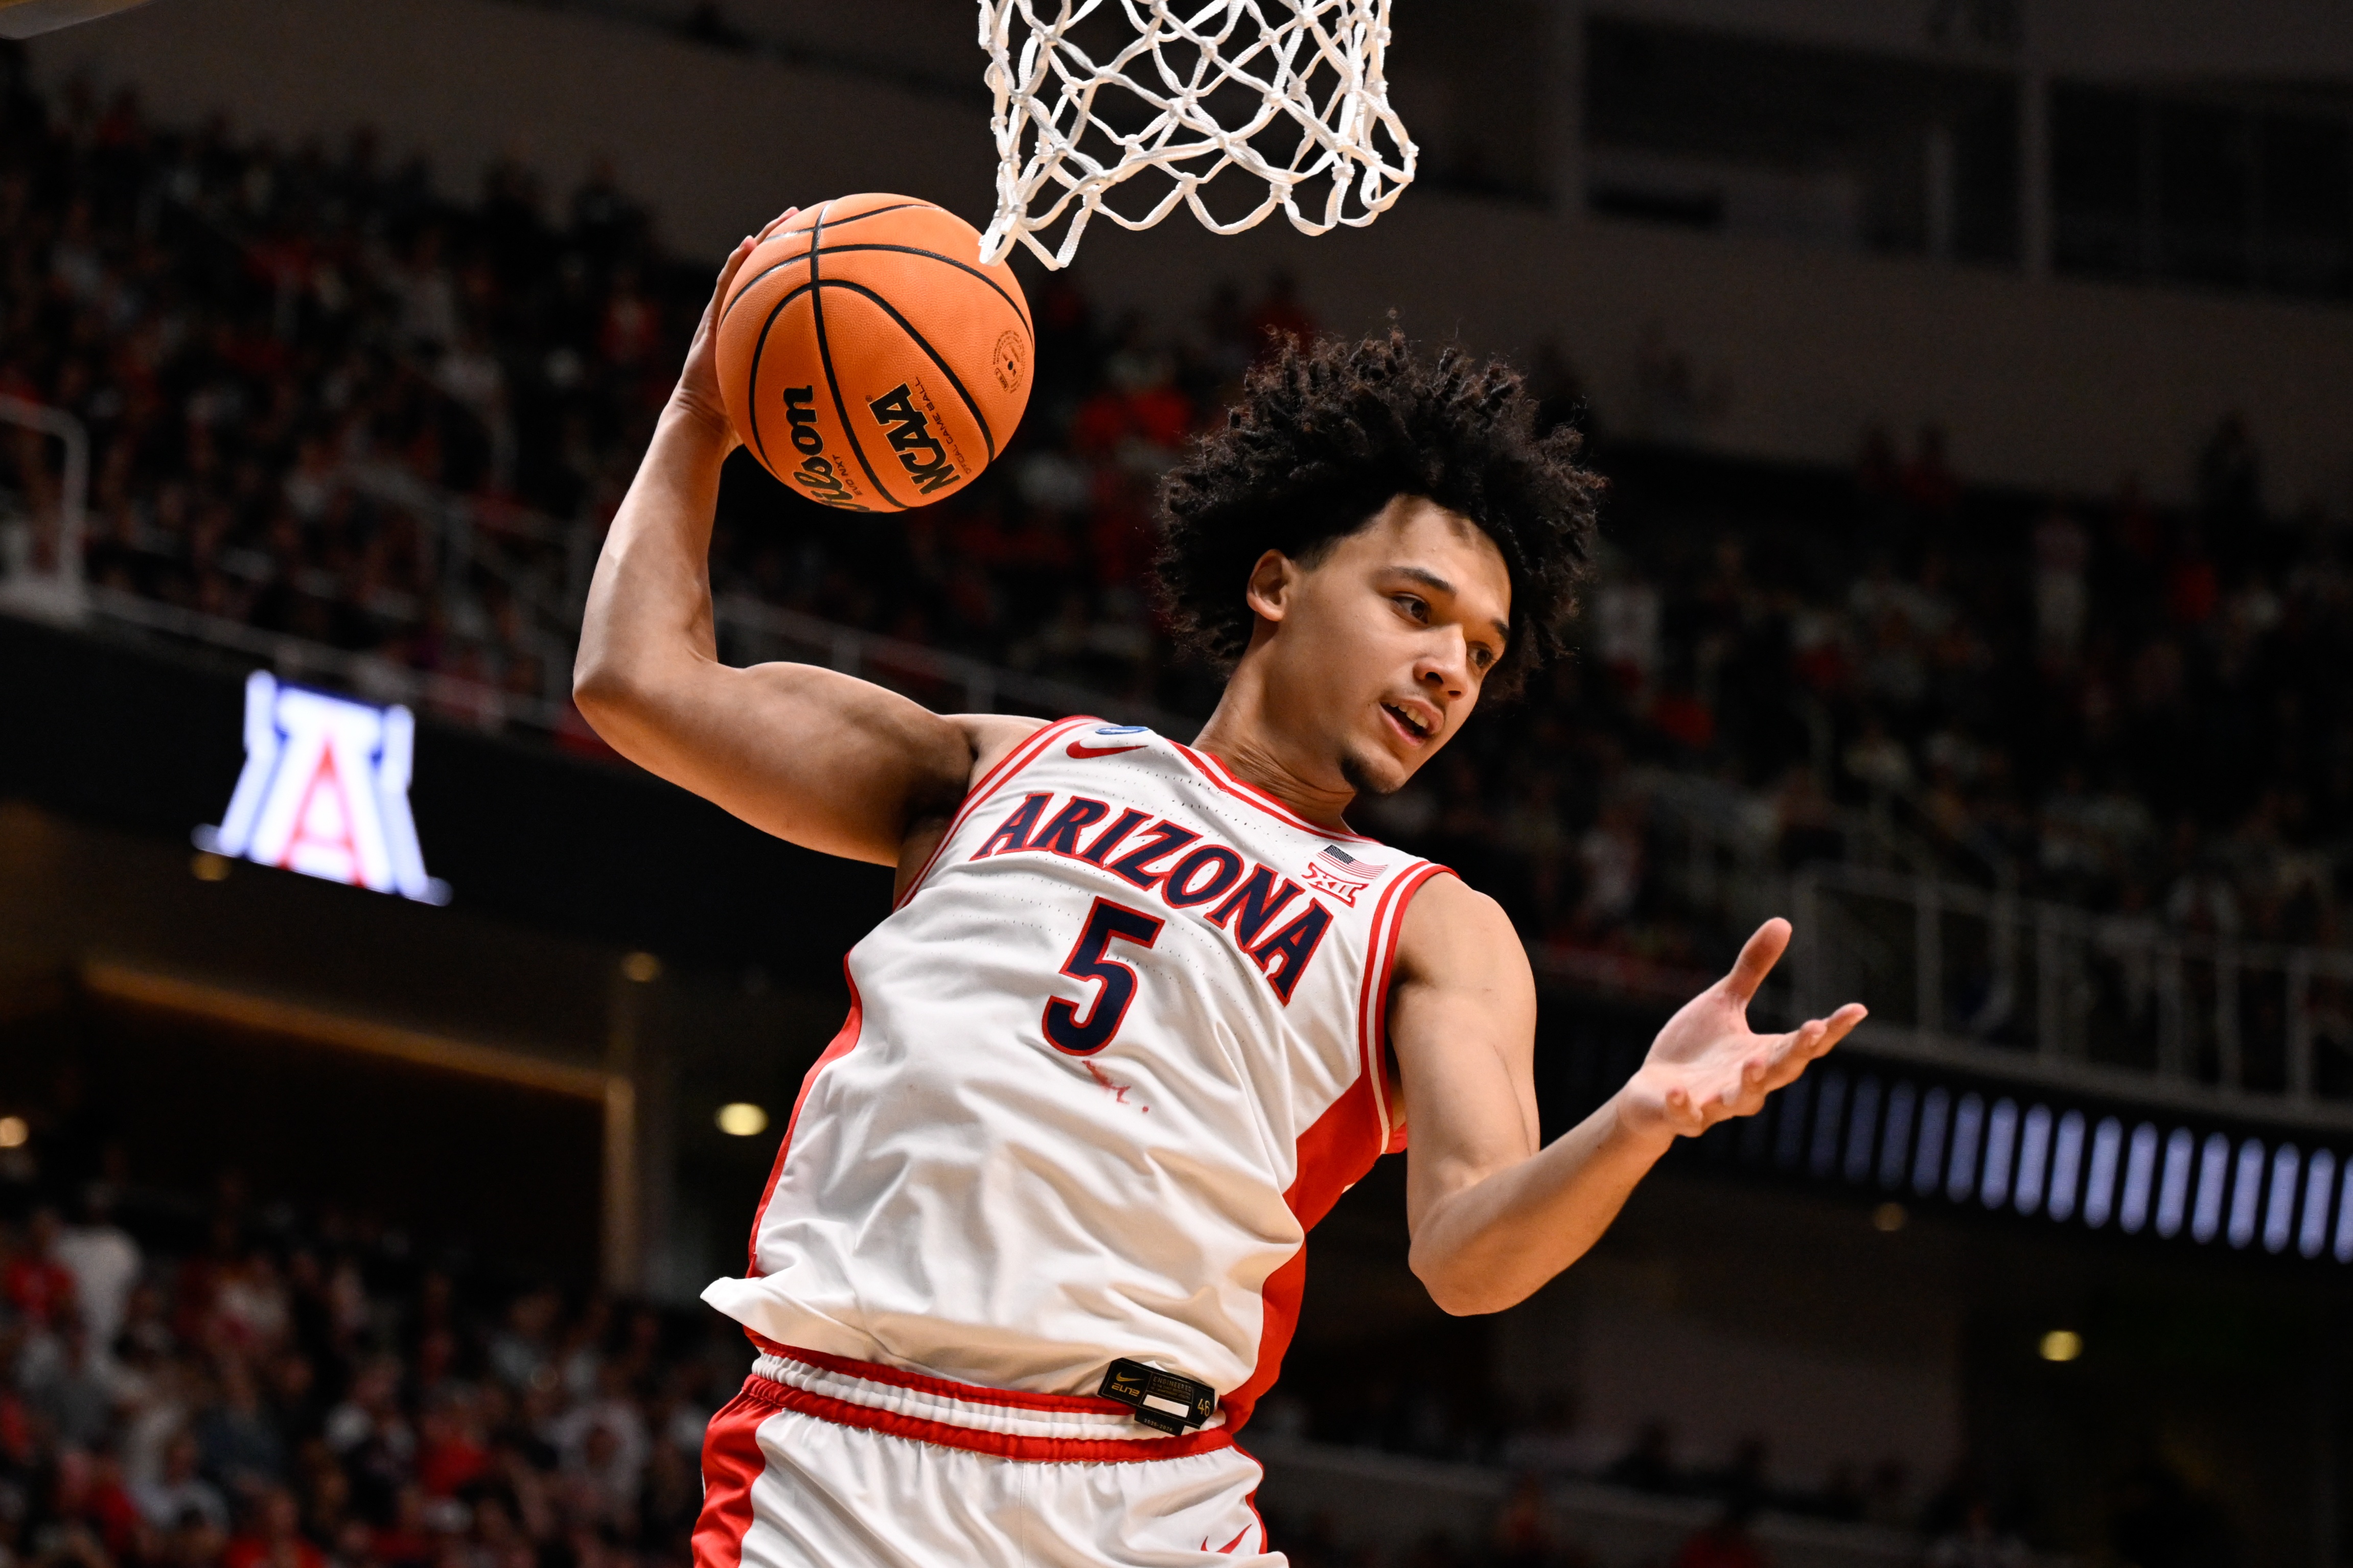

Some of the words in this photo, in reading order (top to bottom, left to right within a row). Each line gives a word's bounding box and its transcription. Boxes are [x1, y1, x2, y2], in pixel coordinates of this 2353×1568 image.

[915, 377, 935, 412] BALL
[867, 382, 962, 496] NCAA
[932, 412, 954, 444] GAME
[783, 385, 870, 512] ilson
[832, 454, 848, 477] NXT
[845, 479, 864, 496] EVO
[970, 792, 1334, 1008] ARIZONA
[1041, 896, 1166, 1057] 5
[1152, 1376, 1192, 1393] ENGINEERED
[1197, 1398, 1211, 1417] 46
